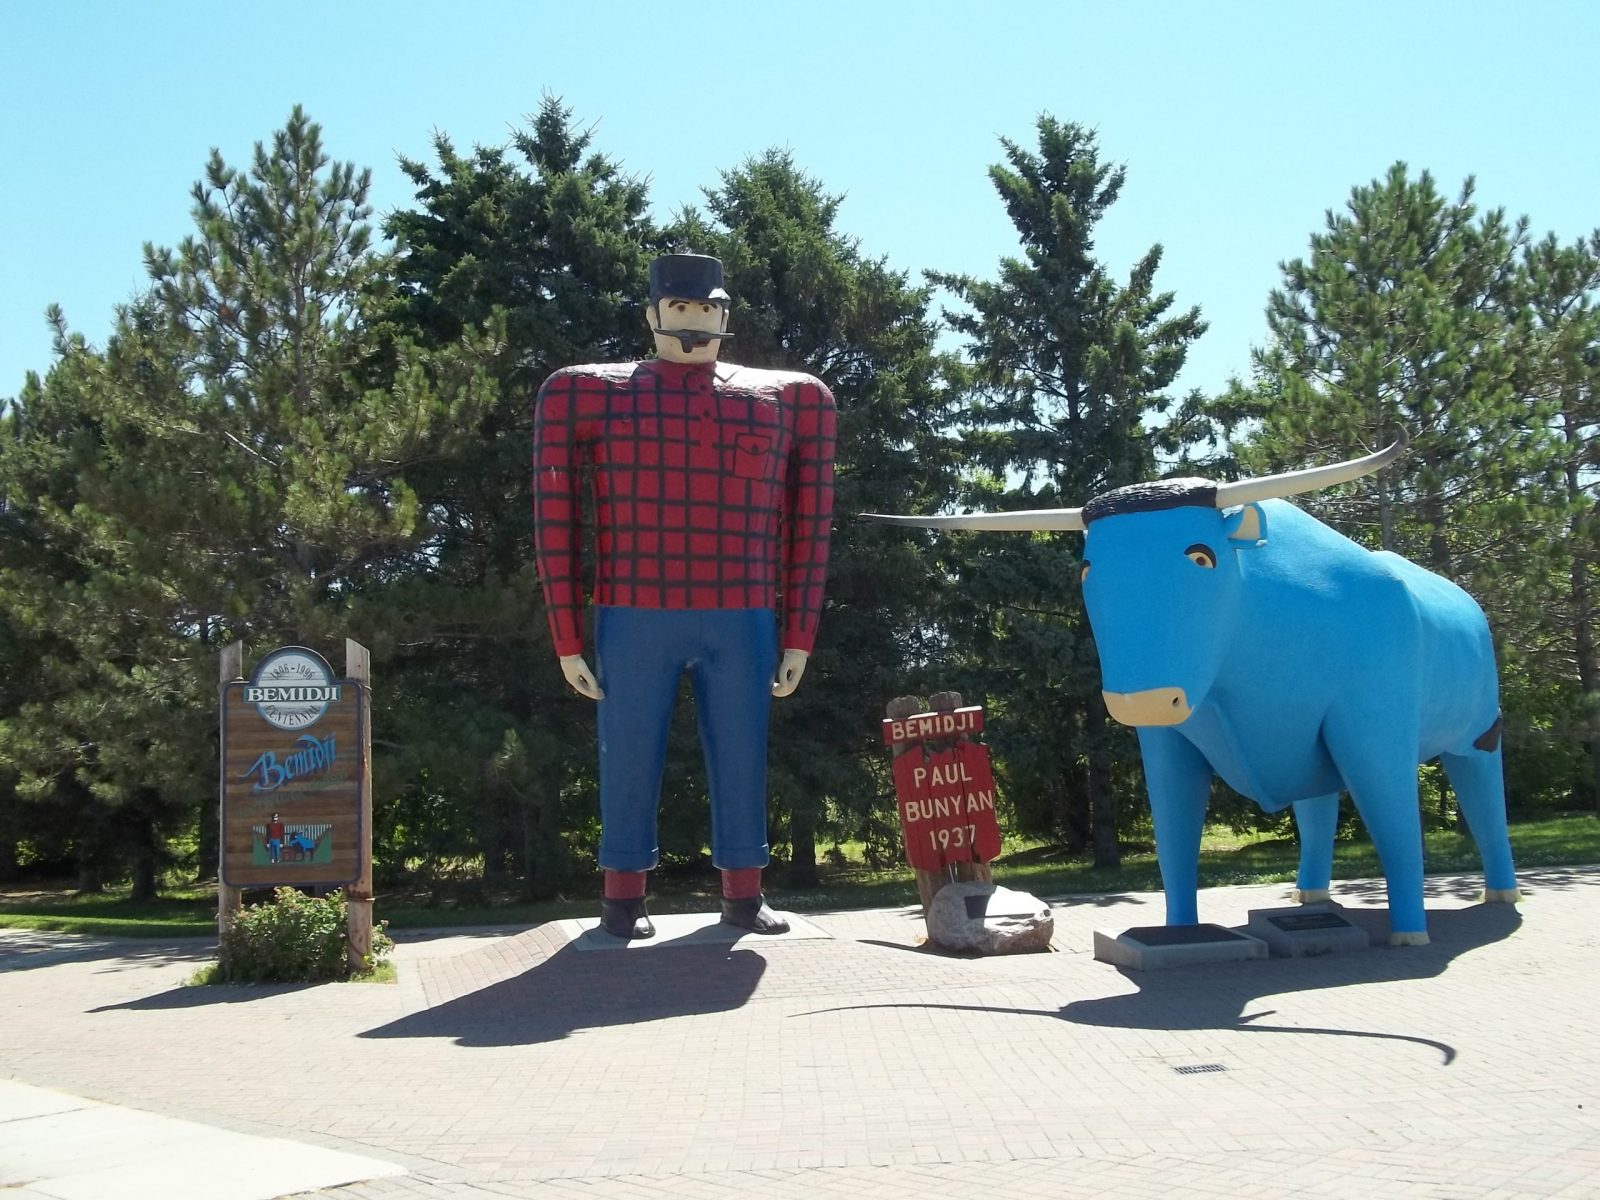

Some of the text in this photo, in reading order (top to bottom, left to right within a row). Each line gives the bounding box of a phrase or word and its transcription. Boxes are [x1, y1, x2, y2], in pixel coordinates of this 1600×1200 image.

[247, 687, 338, 702] BEMIDJI
[265, 704, 320, 725] CENTENNIAL
[892, 713, 974, 740] BEMIDJI
[234, 732, 336, 789] Bemidji
[913, 762, 973, 789] PAUL
[904, 789, 994, 823] BUNYAN
[929, 824, 977, 851] 1937
